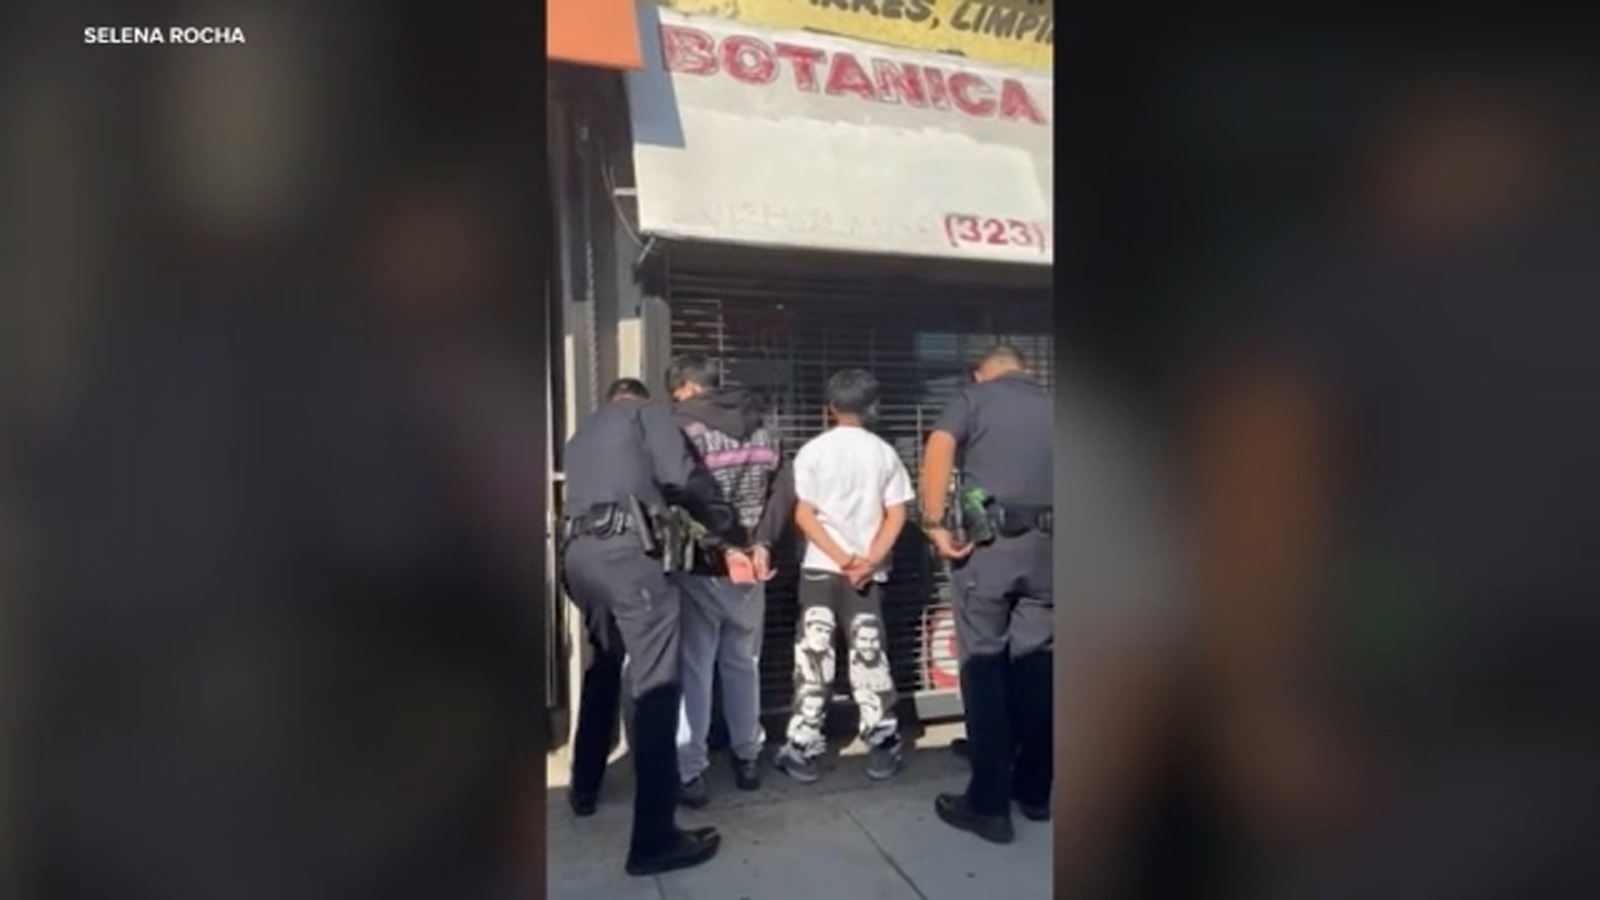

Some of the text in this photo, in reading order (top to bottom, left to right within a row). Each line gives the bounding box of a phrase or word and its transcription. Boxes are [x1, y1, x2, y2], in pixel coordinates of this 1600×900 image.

[949, 0, 1051, 44] LIMPI
[658, 24, 1046, 125] BOTANICA
[944, 212, 1046, 253] (323)
